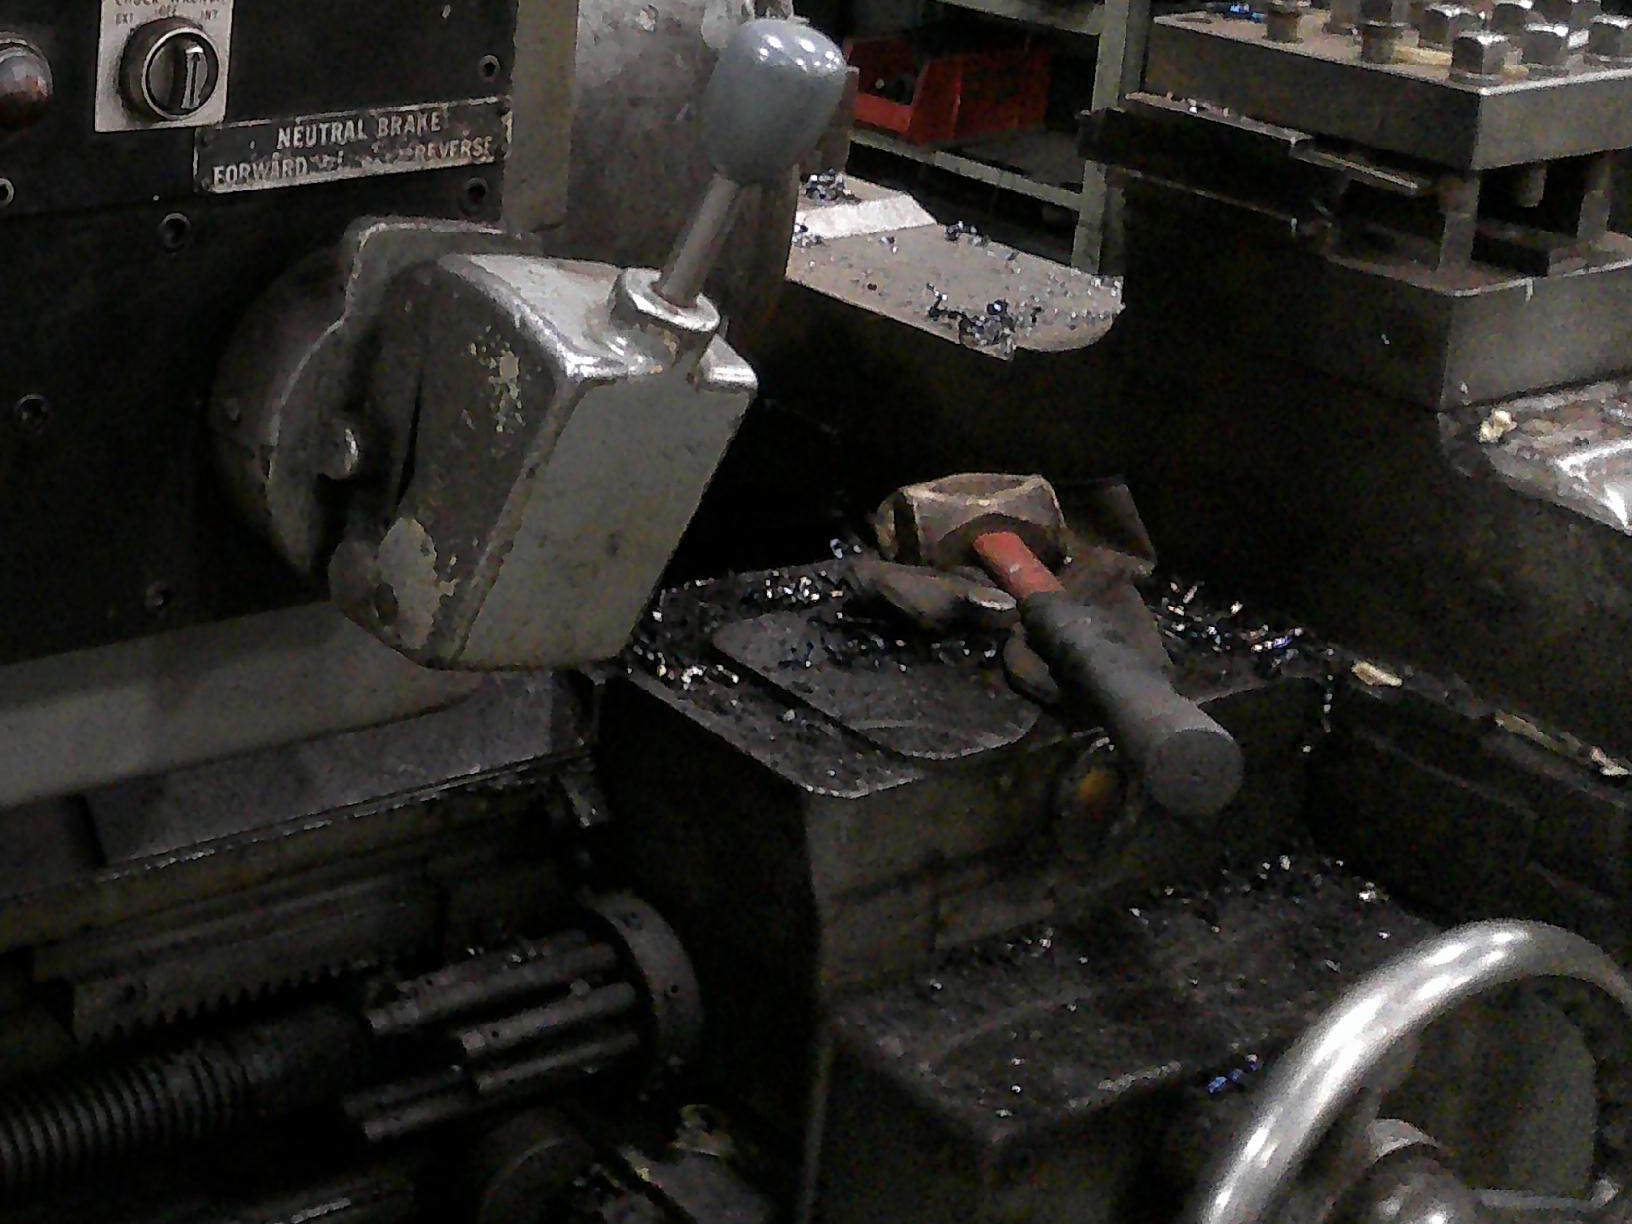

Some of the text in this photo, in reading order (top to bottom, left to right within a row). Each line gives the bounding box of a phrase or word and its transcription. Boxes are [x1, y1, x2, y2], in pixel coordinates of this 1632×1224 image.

[277, 112, 441, 149] NEUTRAL BRAKE
[213, 136, 494, 186] FORWARD REVERSE
